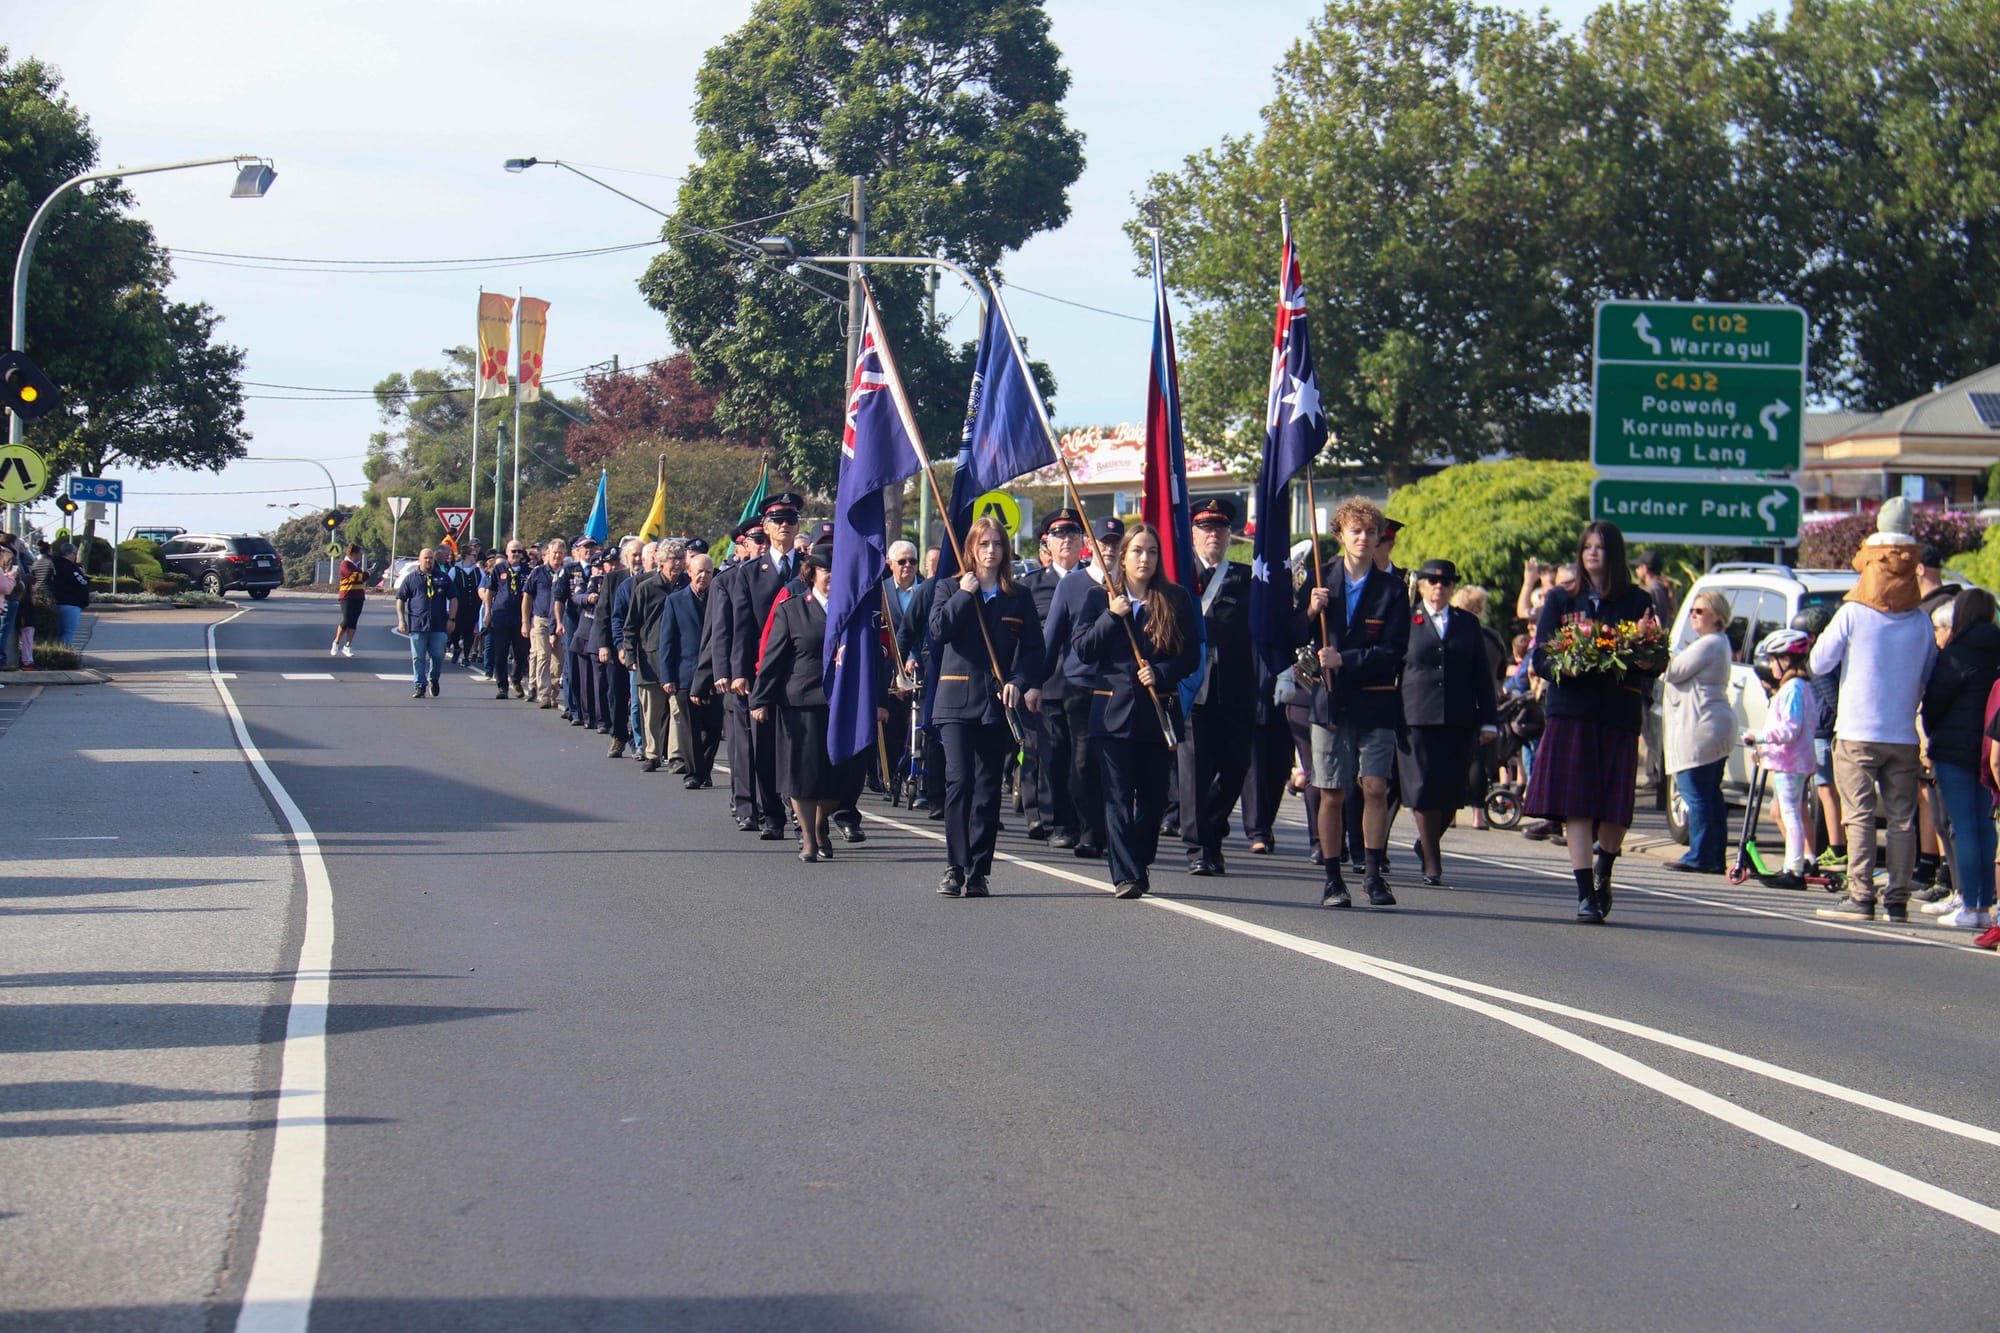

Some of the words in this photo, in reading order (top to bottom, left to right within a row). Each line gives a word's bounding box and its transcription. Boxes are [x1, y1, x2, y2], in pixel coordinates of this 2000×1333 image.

[1692, 314, 1748, 334] C102
[1670, 337, 1770, 360] Warragul
[1655, 372, 1718, 391] C432
[1642, 396, 1736, 420] Poowong
[1622, 418, 1754, 439] Korumburra
[1629, 442, 1681, 464] Lang
[1694, 444, 1746, 466] Lang
[73, 482, 84, 495] P
[1603, 497, 1688, 516] Lardner
[1702, 500, 1752, 518] Park
